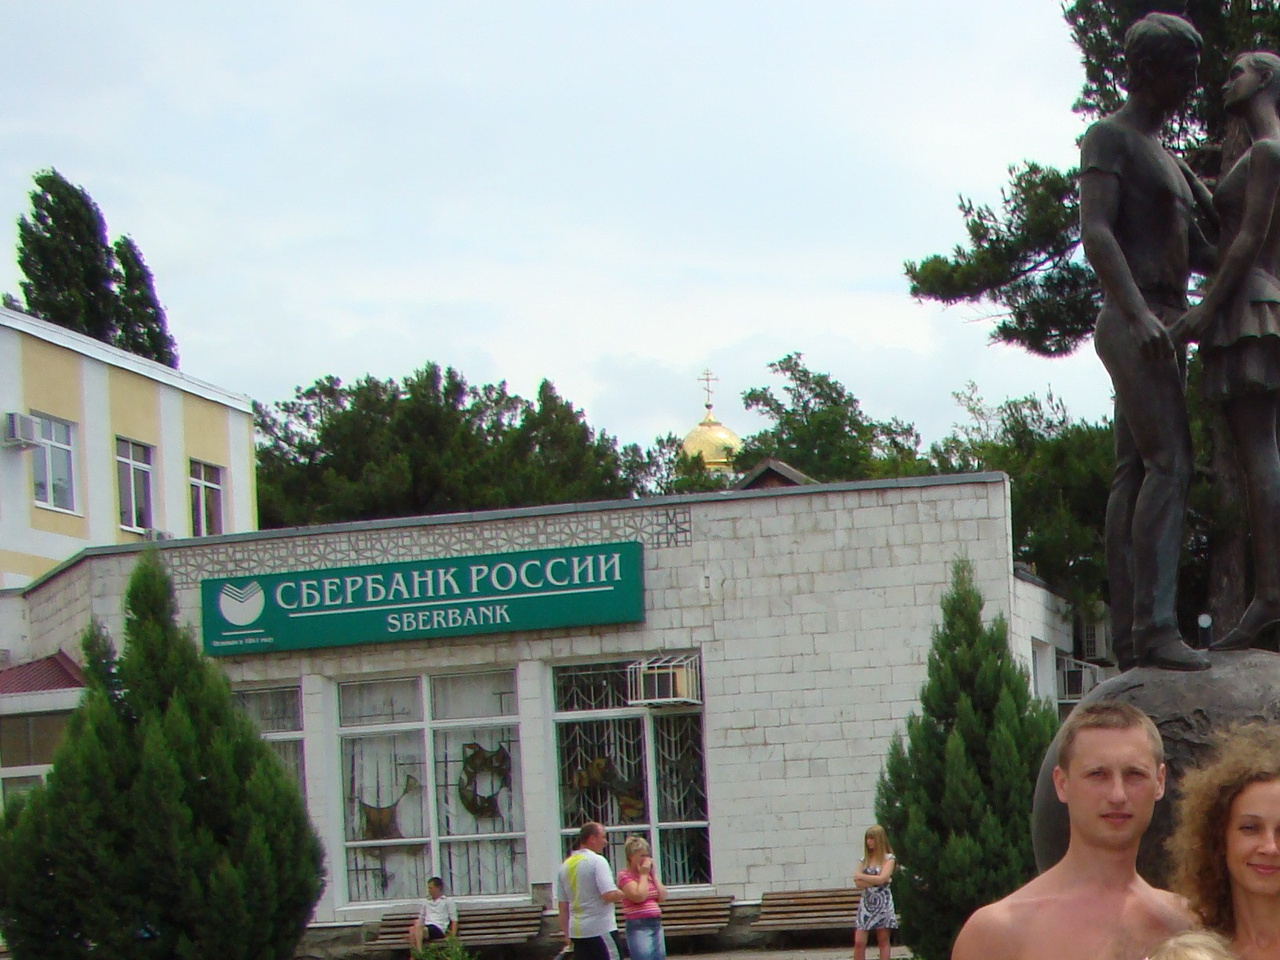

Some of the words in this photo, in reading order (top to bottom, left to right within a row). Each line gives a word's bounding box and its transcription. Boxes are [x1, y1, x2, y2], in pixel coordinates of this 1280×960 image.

[275, 567, 462, 609] СБЕРБАНК
[469, 553, 623, 593] РОССИИ
[387, 604, 512, 633] SBERBANK
